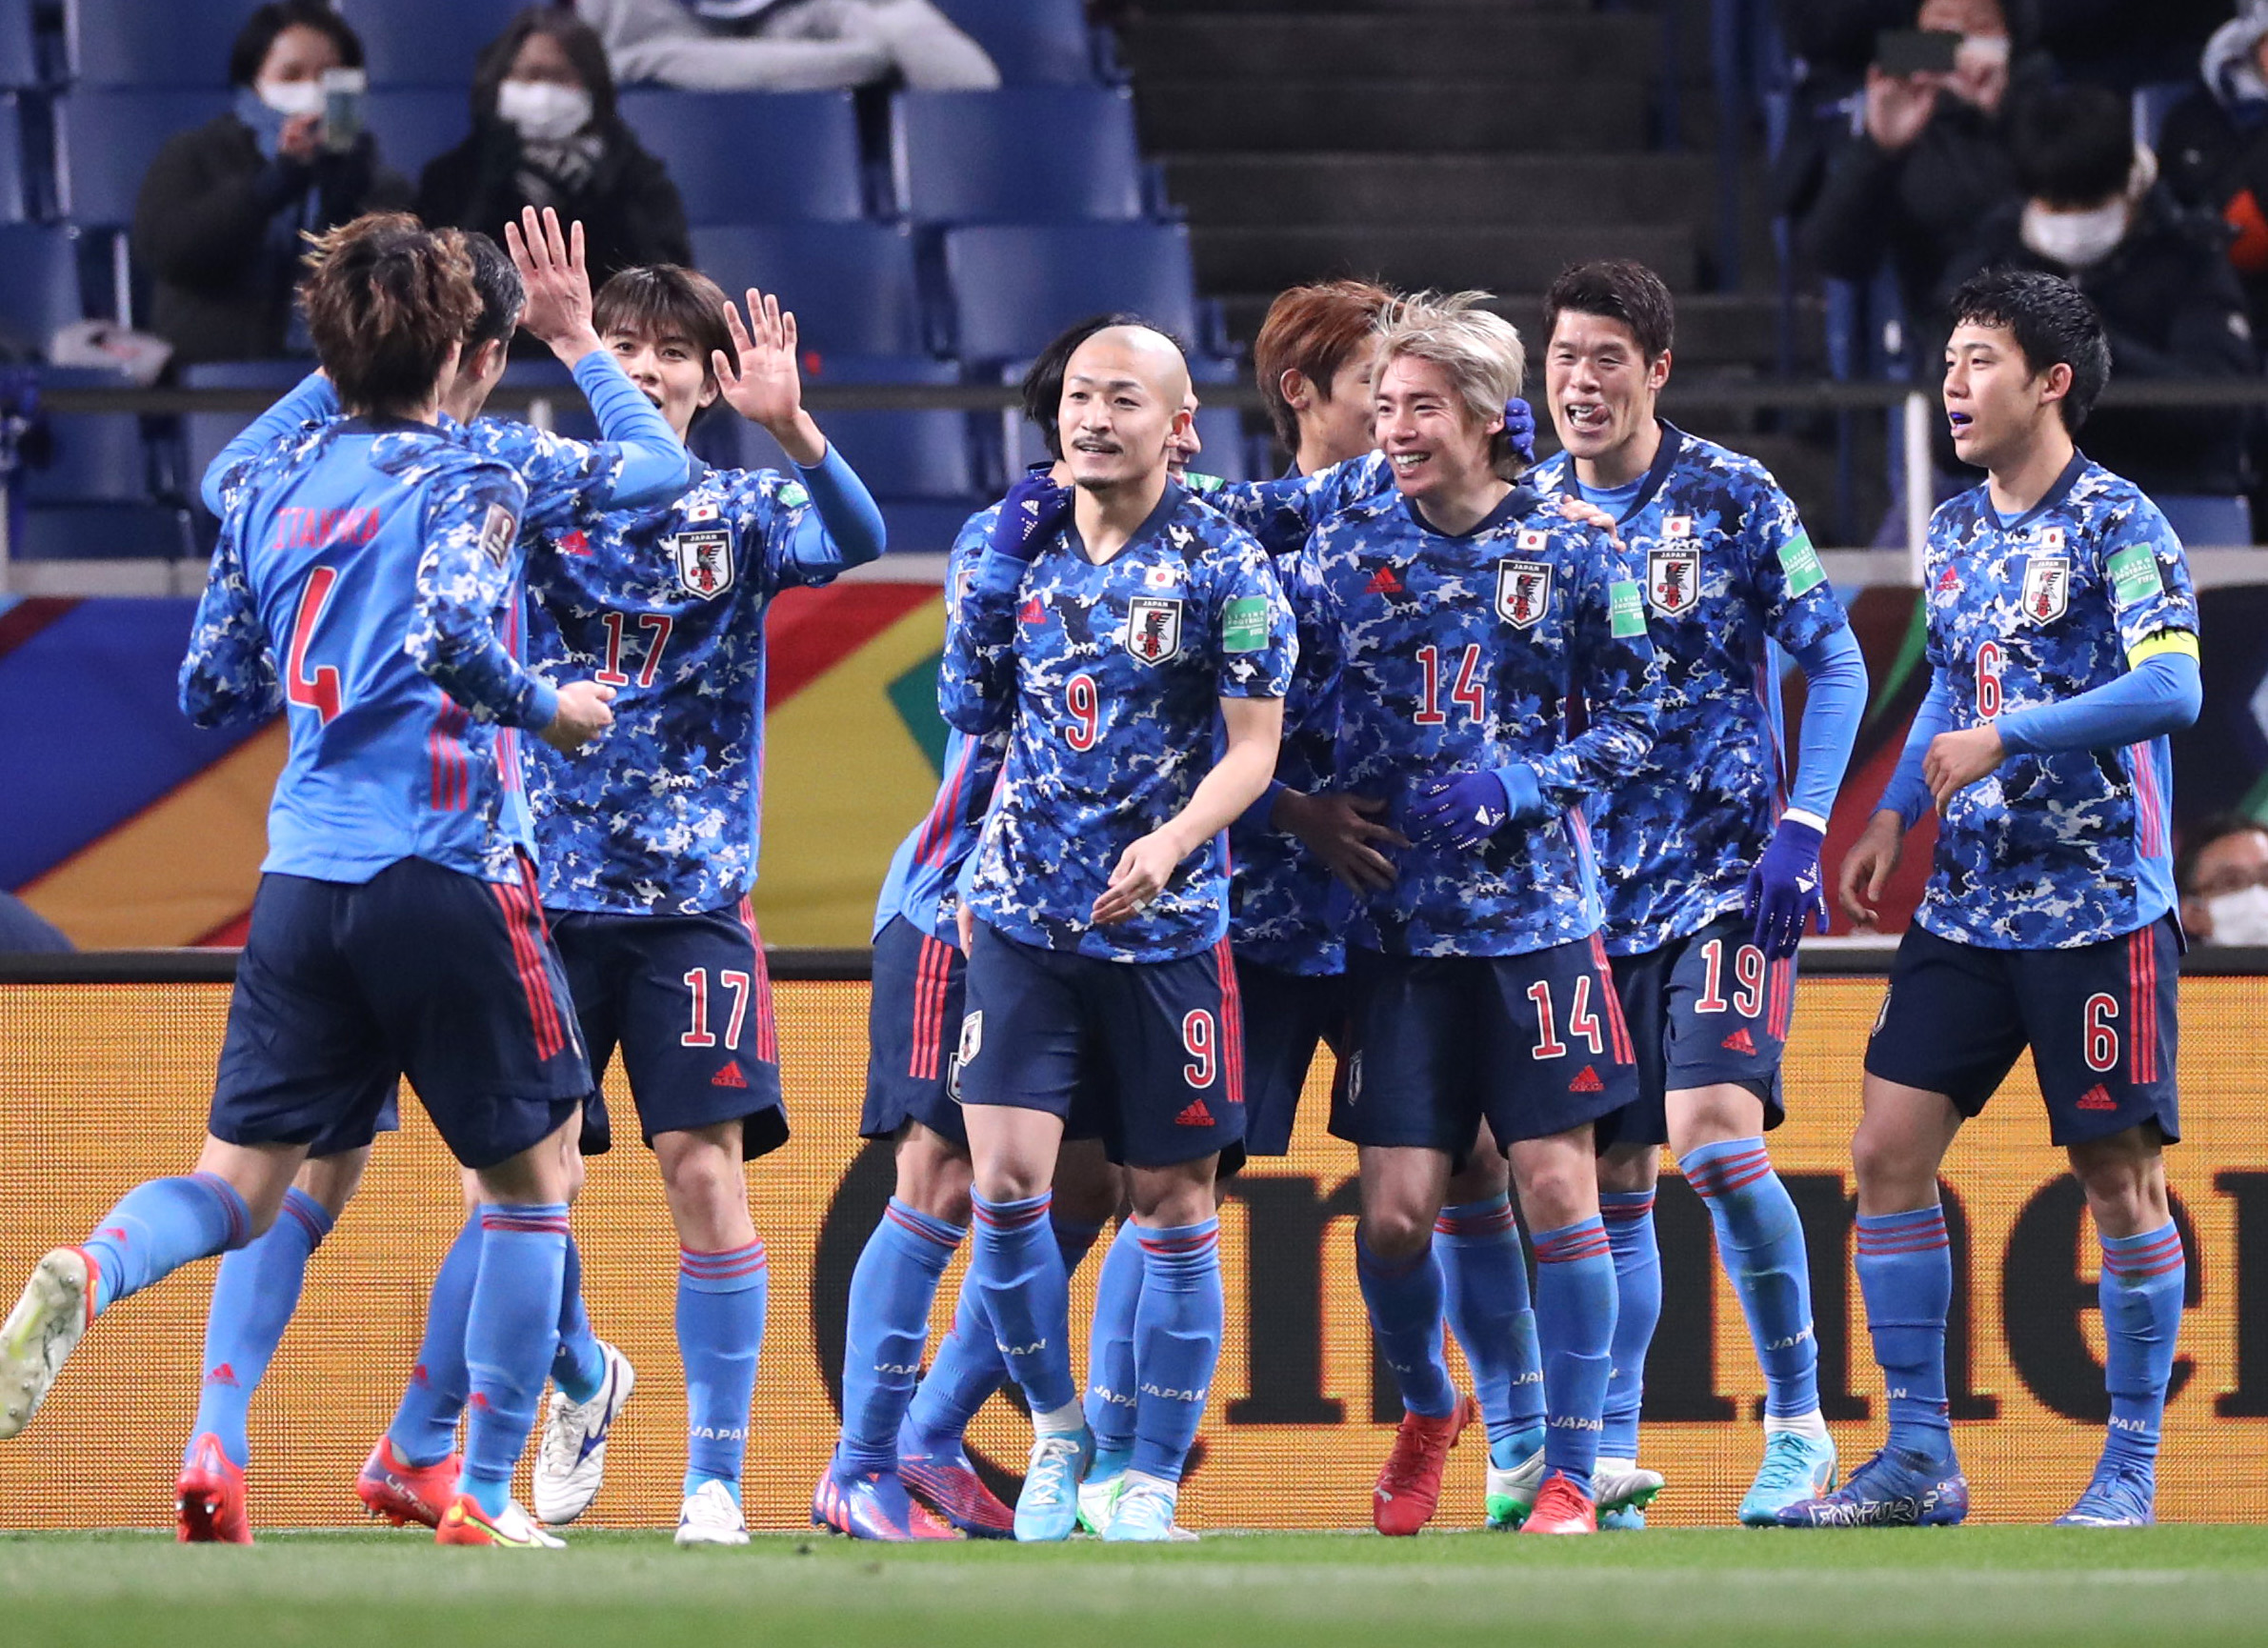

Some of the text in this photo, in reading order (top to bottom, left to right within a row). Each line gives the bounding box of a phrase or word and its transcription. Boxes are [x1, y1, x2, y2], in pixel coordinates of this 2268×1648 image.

[690, 533, 717, 542] JAPAN
[1513, 563, 1540, 572] JAPAN
[287, 565, 344, 726] 4
[594, 611, 673, 689] 17
[1414, 643, 1485, 725] 14
[1976, 640, 2002, 720] 6
[1065, 673, 1098, 753] 9
[681, 967, 750, 1050] 17
[1694, 936, 1767, 1018] 19
[1182, 1008, 1216, 1089] 9
[1526, 975, 1604, 1060] 14
[2083, 992, 2119, 1073] 6
[1094, 1384, 1137, 1408] JAPA
[1139, 1382, 1206, 1402] JAPAN
[2108, 1416, 2146, 1433] PAN
